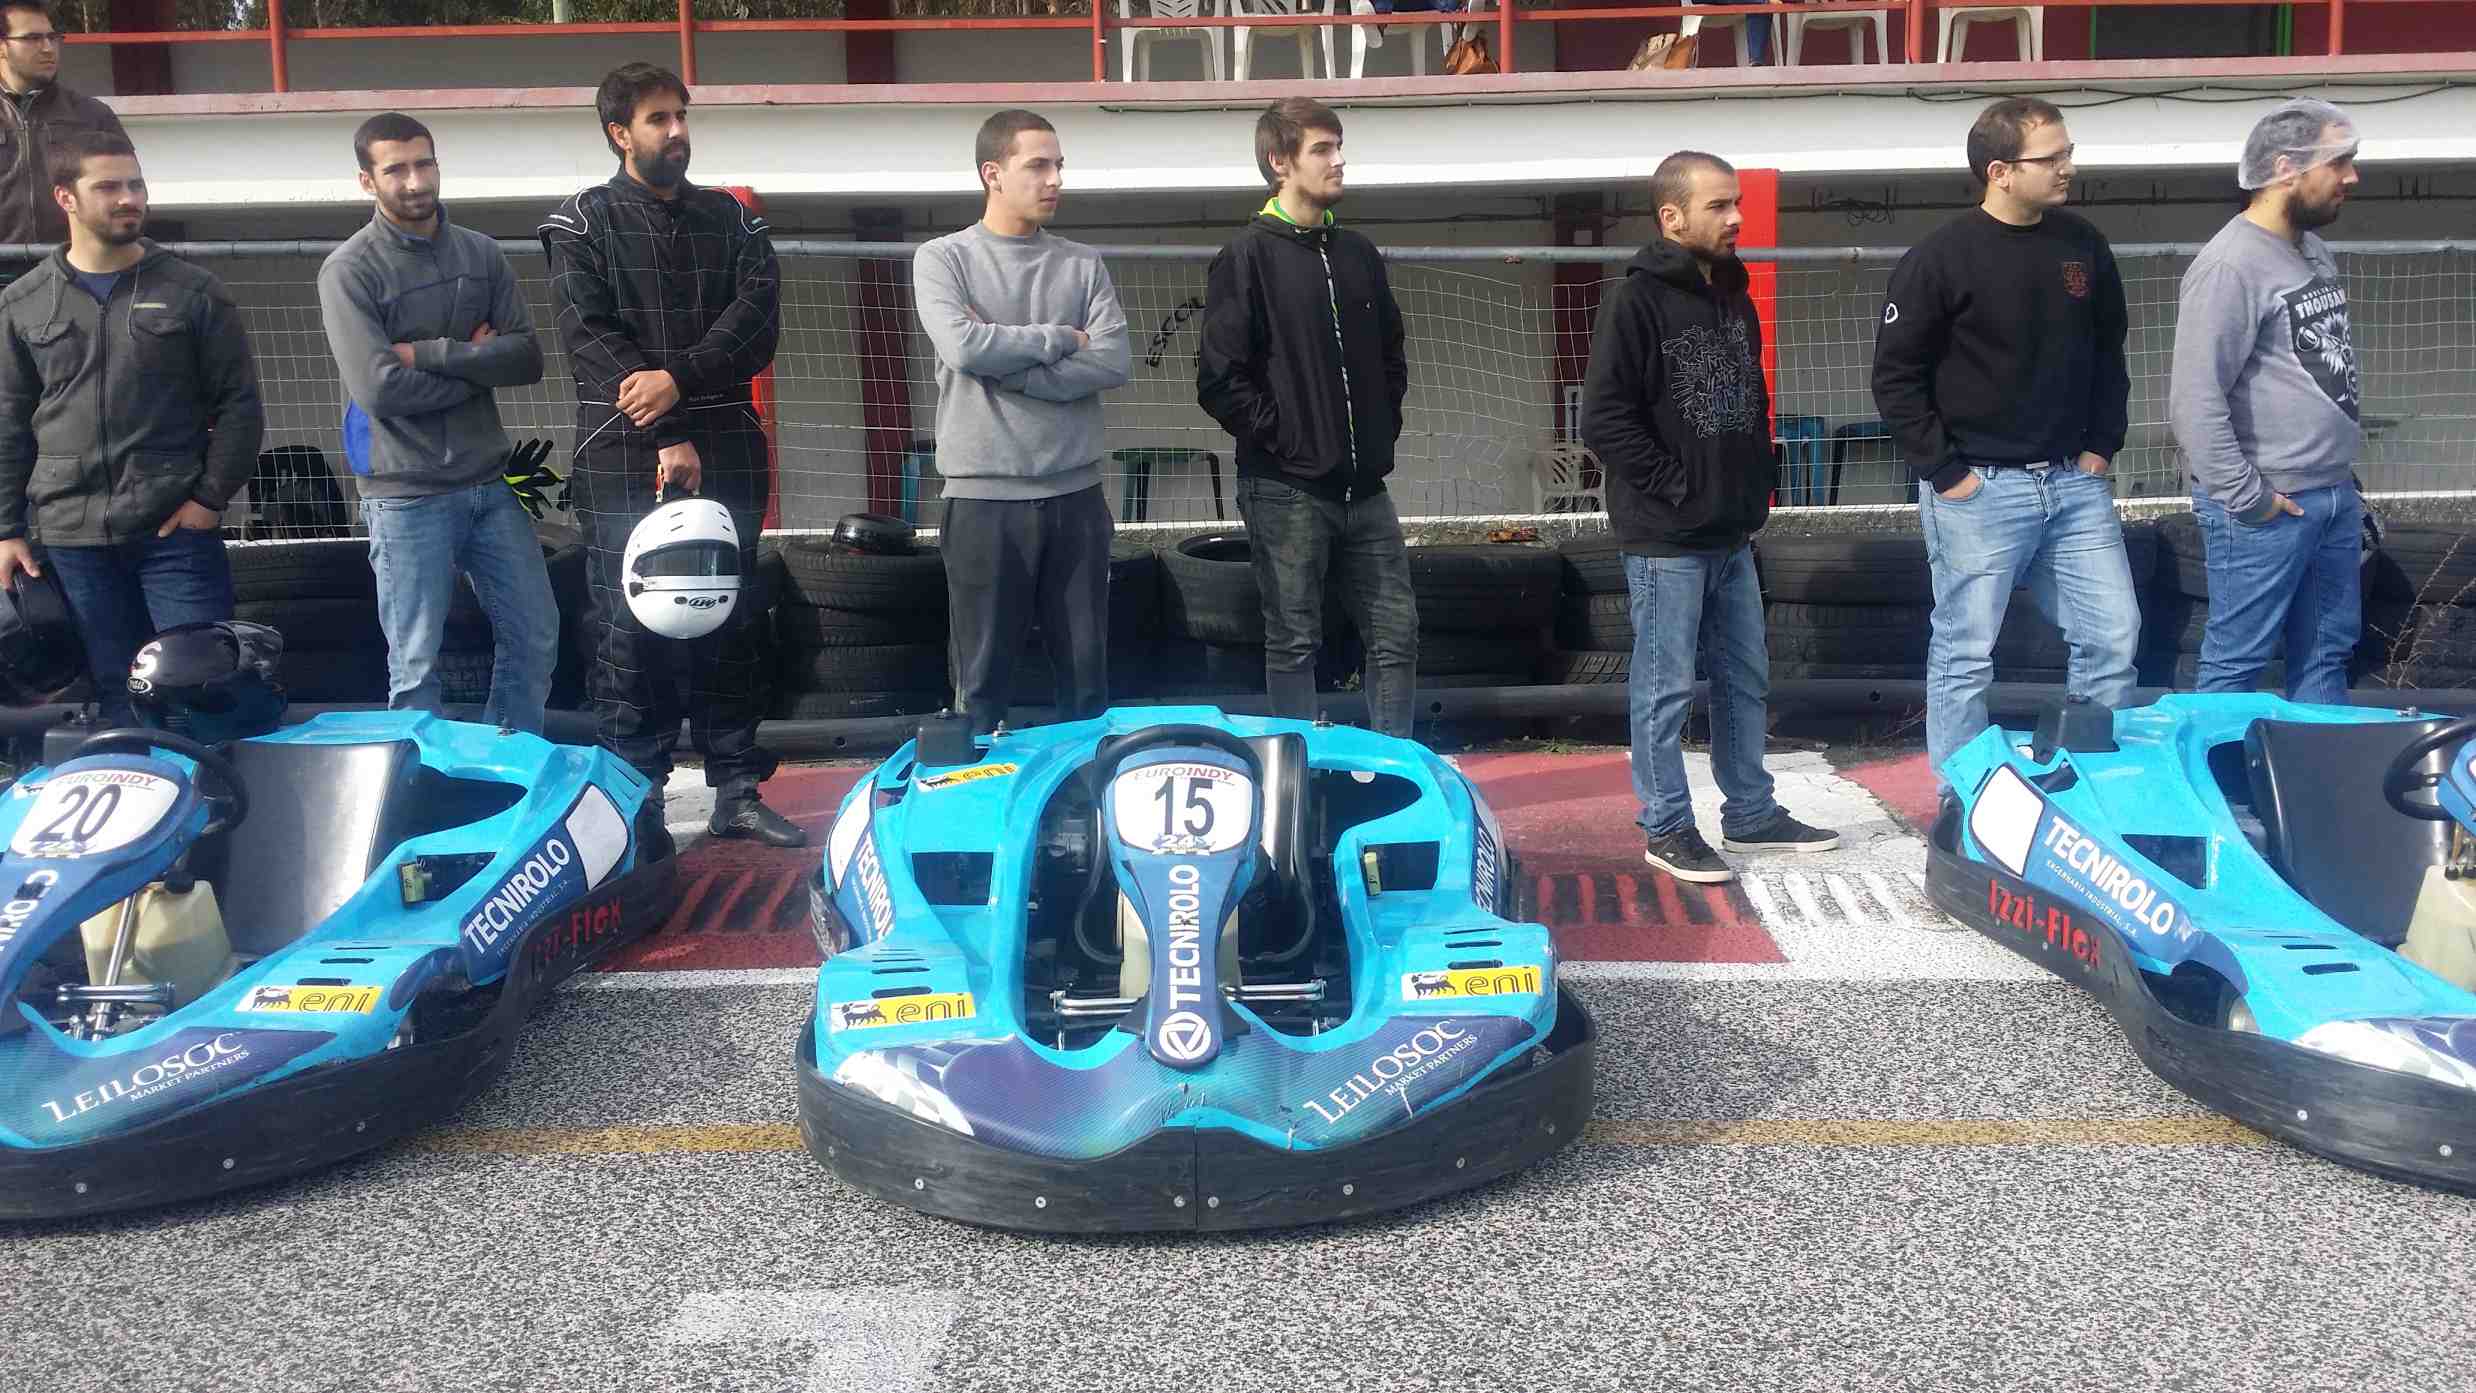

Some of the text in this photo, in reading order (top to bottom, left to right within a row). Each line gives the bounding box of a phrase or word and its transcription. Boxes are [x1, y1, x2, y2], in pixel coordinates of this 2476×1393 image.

[30, 784, 122, 843] 20
[1154, 776, 1214, 836] 15
[465, 839, 570, 954] TECNIROLO
[2043, 815, 2175, 935] TECNIROLO
[1169, 864, 1201, 1010] TECNIROLO
[299, 986, 374, 1012] eni
[896, 992, 966, 1024] eni
[1466, 967, 1535, 996] eni
[41, 1032, 244, 1123] LEILOSOC
[129, 1050, 250, 1102] MARKET PARTNERS
[1303, 1018, 1466, 1124] LEILOSOC
[1385, 1033, 1478, 1096] MARKET PARTNERS
